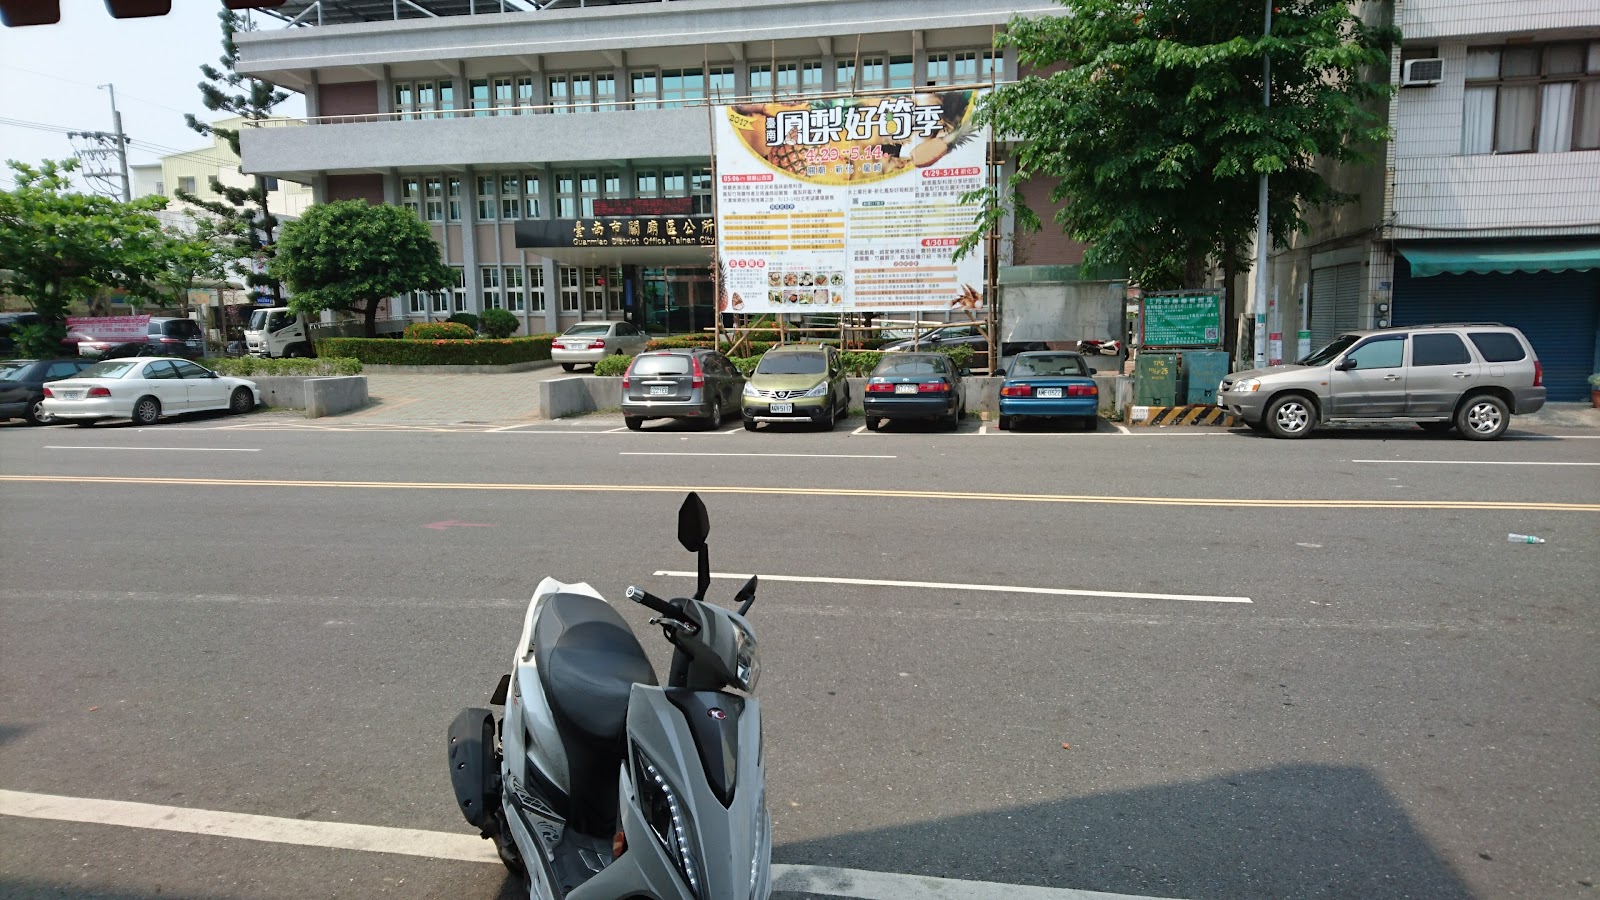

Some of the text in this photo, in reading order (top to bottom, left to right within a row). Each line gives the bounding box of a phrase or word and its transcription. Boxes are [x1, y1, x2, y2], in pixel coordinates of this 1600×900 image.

[729, 114, 749, 128] 2017
[573, 219, 715, 237] 臺南市關廟區公所
[612, 237, 640, 245] District
[699, 235, 715, 245] City
